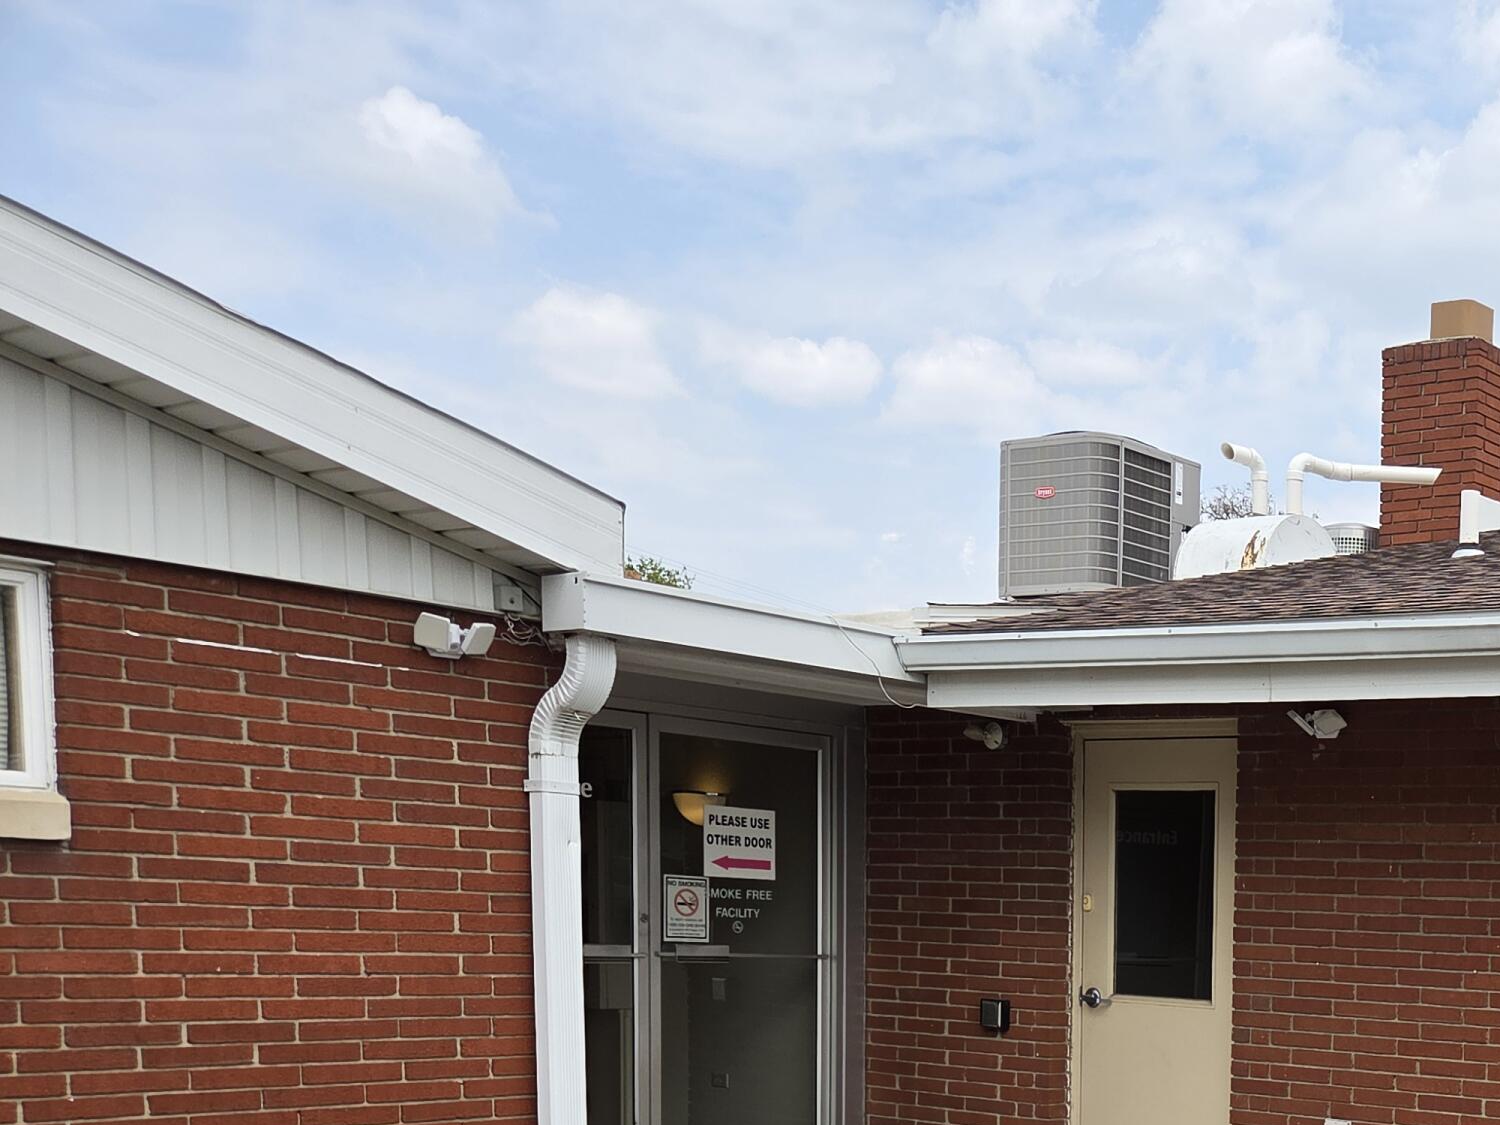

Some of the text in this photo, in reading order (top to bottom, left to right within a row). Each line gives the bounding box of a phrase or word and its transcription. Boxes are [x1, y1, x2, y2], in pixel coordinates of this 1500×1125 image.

[708, 814, 770, 830] PLEASE USE
[706, 833, 773, 849] OTHER DOOR
[705, 888, 773, 900] MOKE FREE
[715, 907, 760, 919] FACILITY
